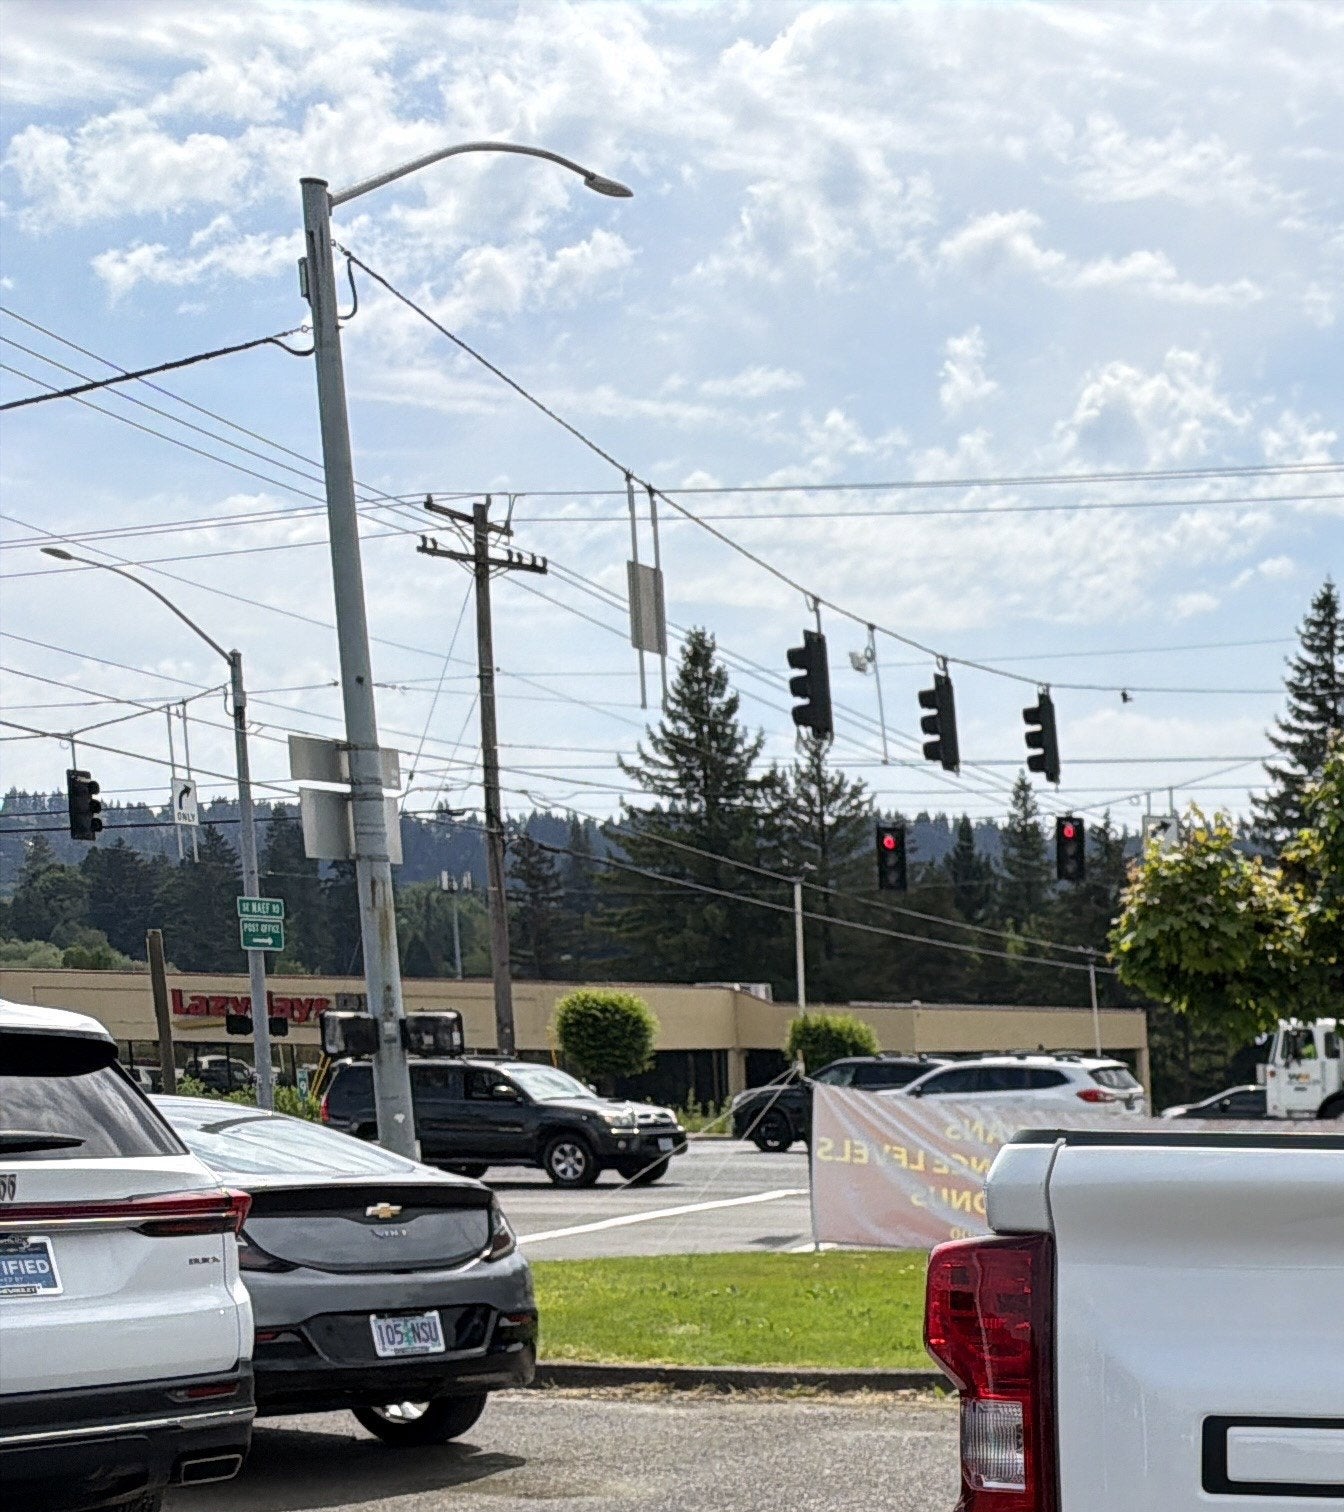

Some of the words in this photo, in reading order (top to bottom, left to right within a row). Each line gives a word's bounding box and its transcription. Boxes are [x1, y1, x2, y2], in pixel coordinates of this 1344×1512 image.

[177, 811, 196, 823] ONLY
[243, 923, 259, 933] POST
[260, 923, 280, 934] OFFICE
[0, 1258, 50, 1276] IFIED
[377, 1323, 405, 1347] 105
[410, 1321, 441, 1345] NSU
